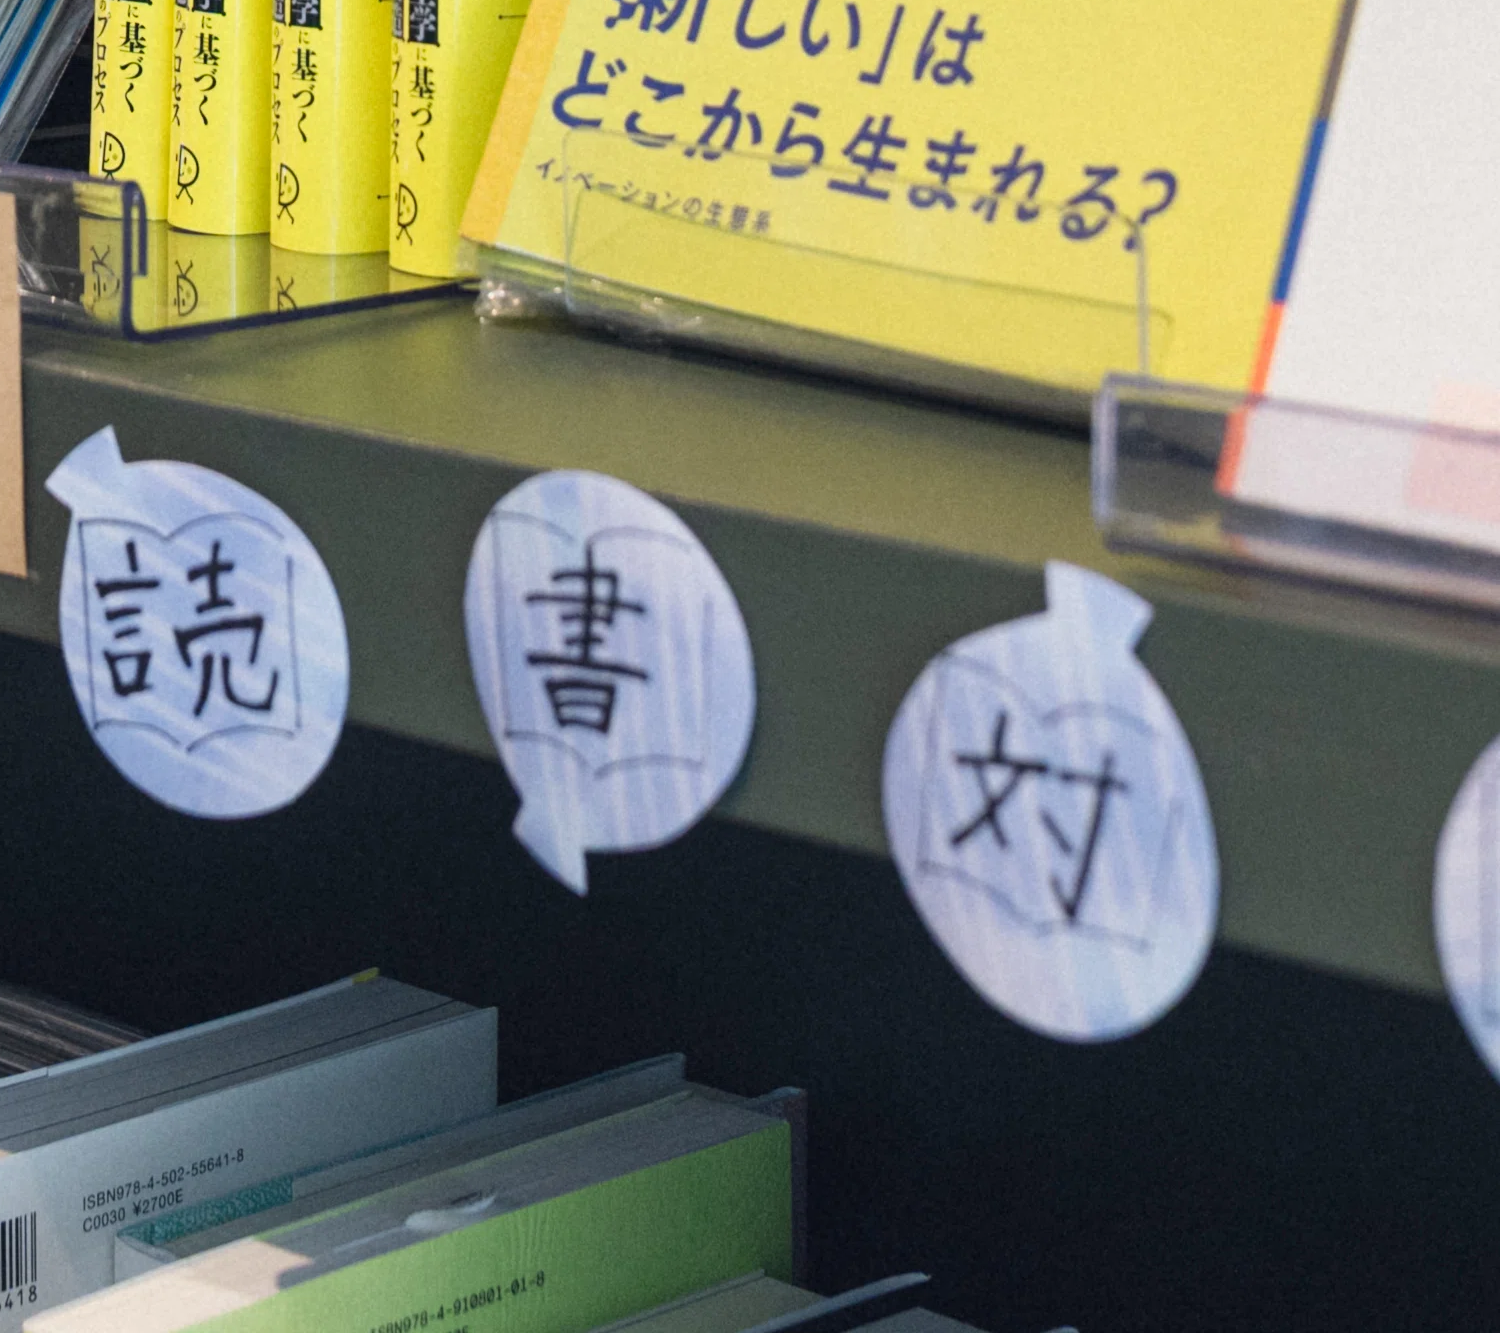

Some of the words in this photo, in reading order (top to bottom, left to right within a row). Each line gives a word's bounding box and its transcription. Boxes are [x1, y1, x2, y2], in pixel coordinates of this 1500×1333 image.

[549, 47, 1178, 253] どこから生まれる？
[95, 541, 279, 717] 読
[525, 535, 650, 736] 書
[949, 711, 1130, 924] 対
[82, 1148, 245, 1212] ISBN978-4-502-55641-8
[82, 1206, 126, 1232] C0030
[133, 1189, 184, 1217] ¥2700E
